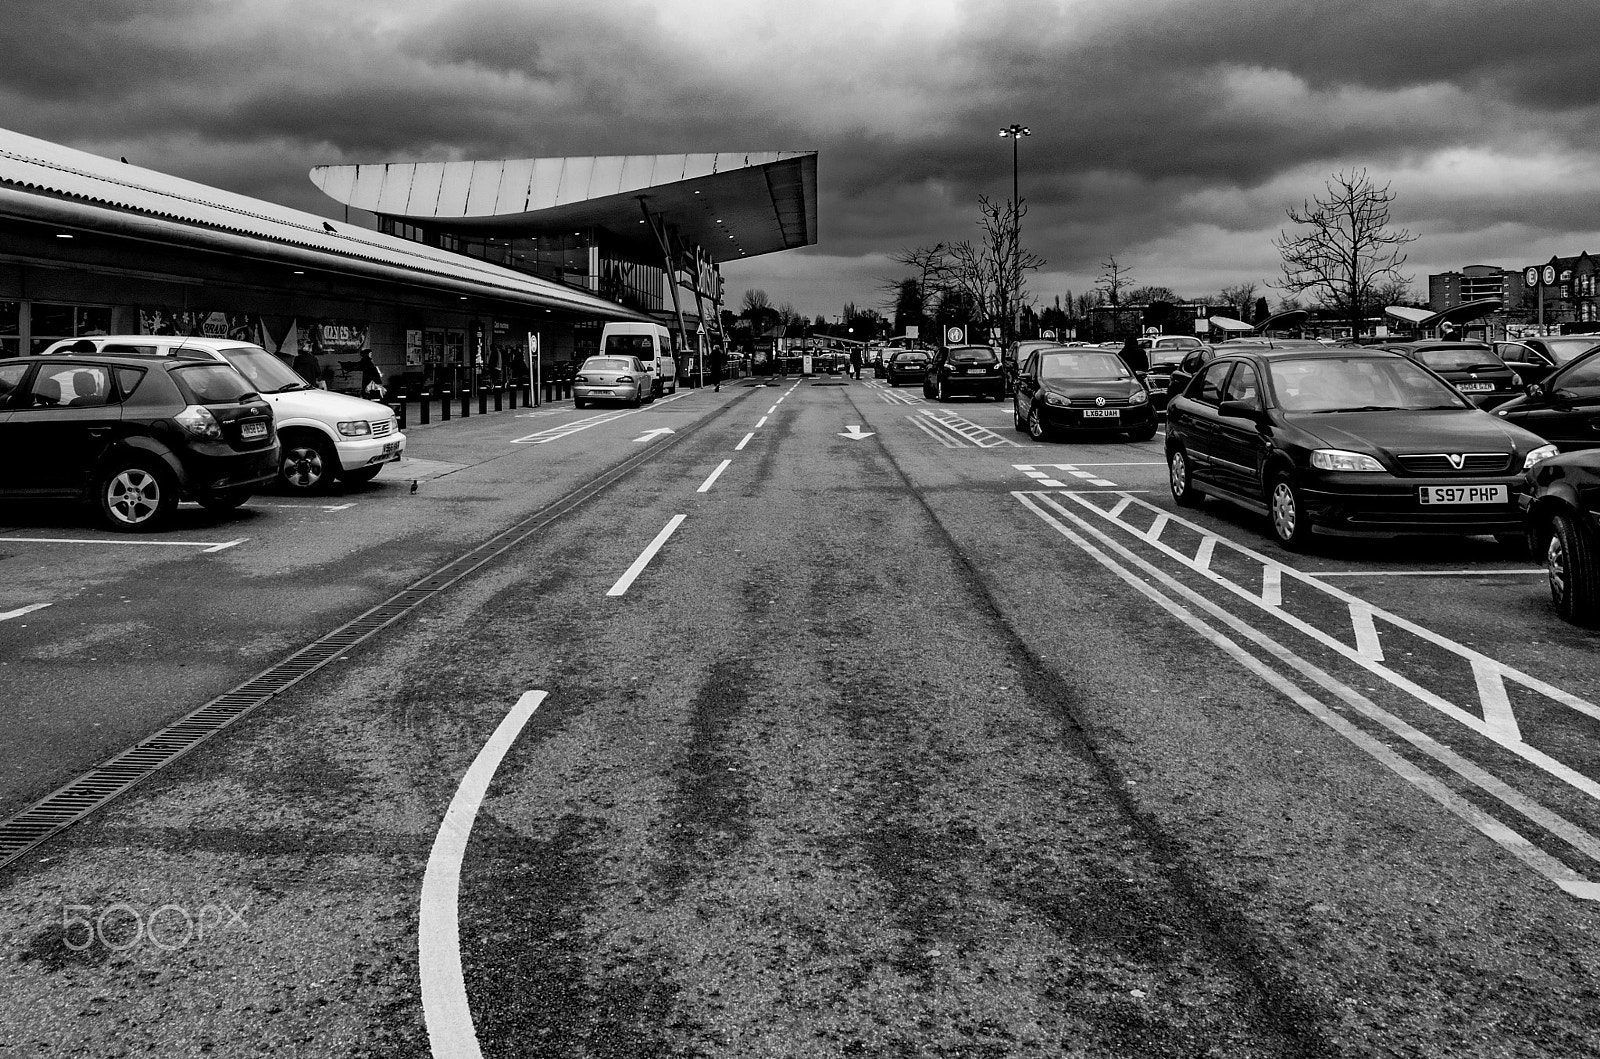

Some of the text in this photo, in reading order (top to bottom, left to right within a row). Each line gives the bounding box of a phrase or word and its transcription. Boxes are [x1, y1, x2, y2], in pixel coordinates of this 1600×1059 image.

[1529, 271, 1535, 283] E
[1546, 269, 1552, 281] E
[204, 323, 227, 335] BRAND
[1435, 487, 1498, 502] S97 PHP
